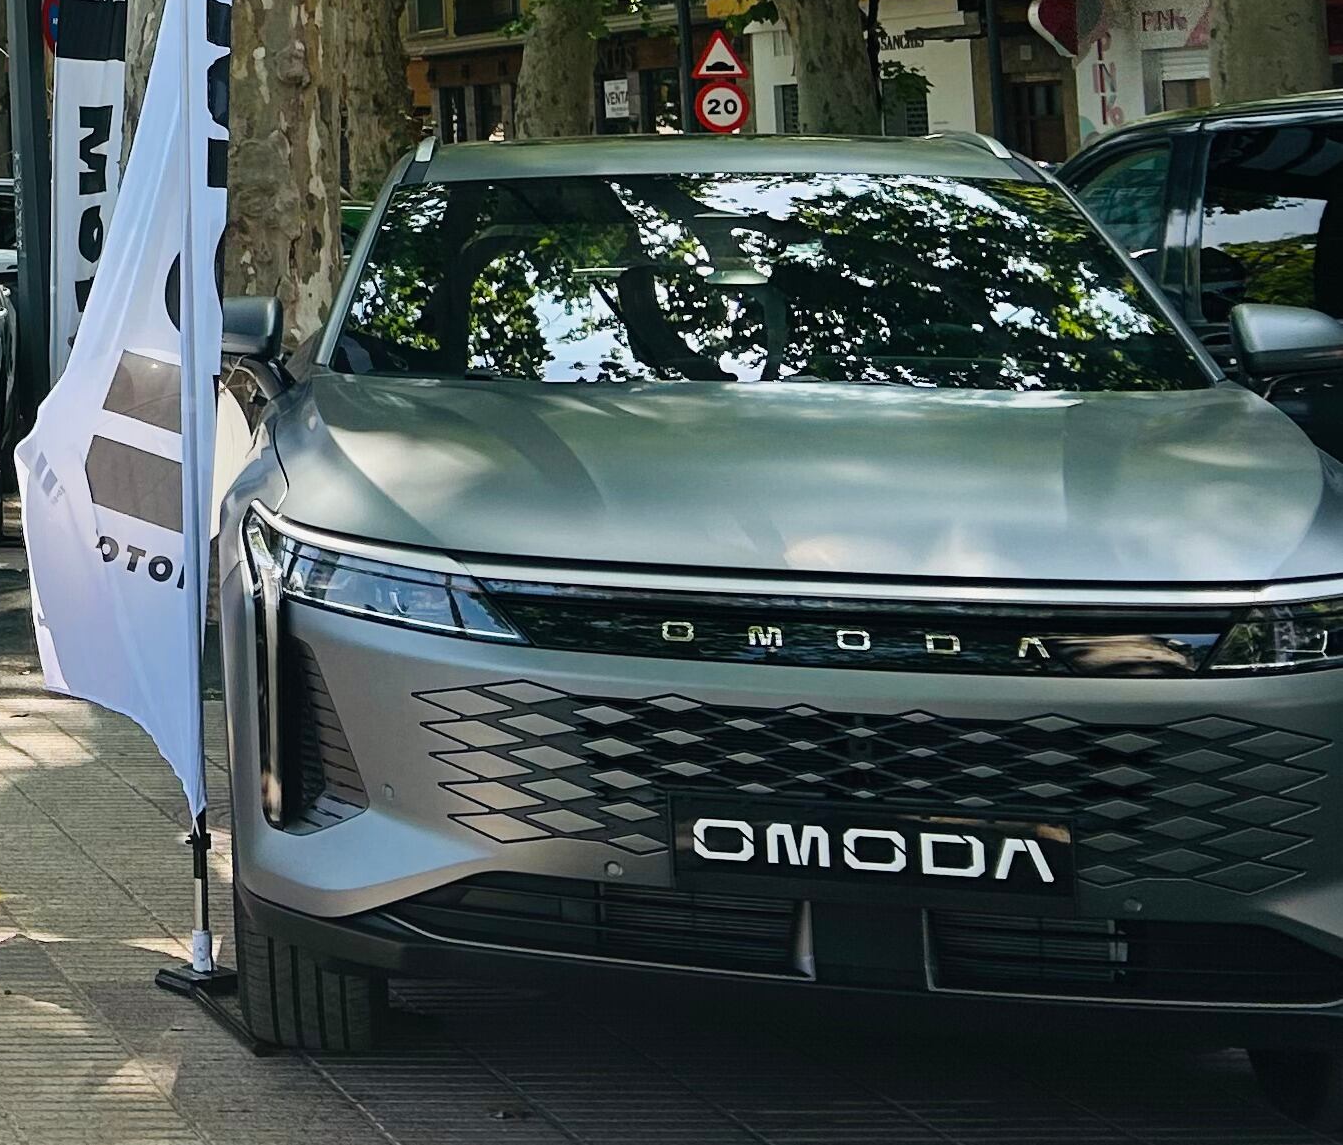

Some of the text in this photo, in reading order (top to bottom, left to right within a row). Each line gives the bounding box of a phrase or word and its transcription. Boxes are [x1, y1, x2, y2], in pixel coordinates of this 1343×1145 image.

[707, 99, 738, 115] 20
[661, 621, 1051, 659] OMODA
[693, 818, 1055, 883] OMODA
